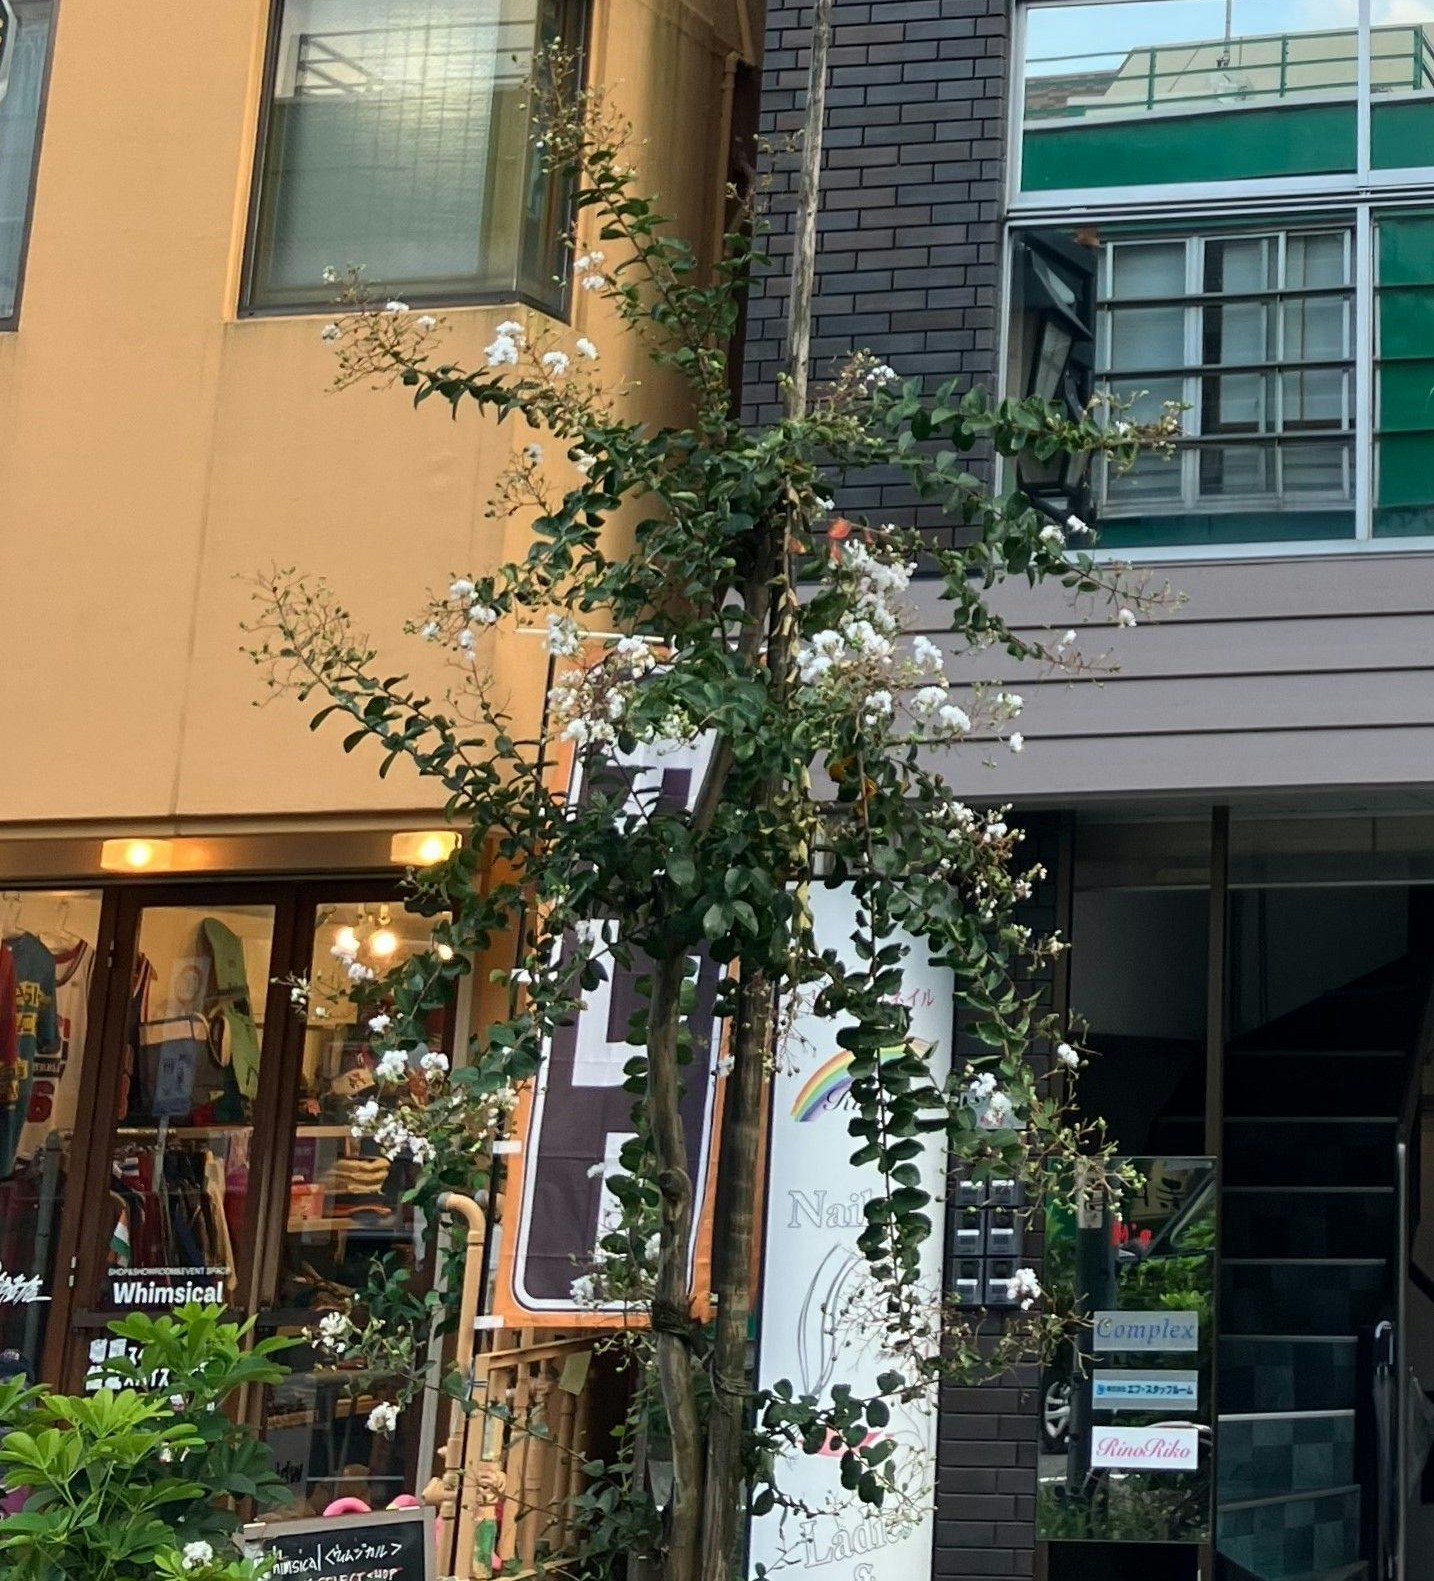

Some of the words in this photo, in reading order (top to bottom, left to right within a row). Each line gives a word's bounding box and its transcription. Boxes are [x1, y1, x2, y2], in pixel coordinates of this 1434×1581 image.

[113, 1280, 224, 1304] Whimsical
[1096, 1317, 1195, 1345] Complex
[1096, 1437, 1192, 1459] RinoRiko
